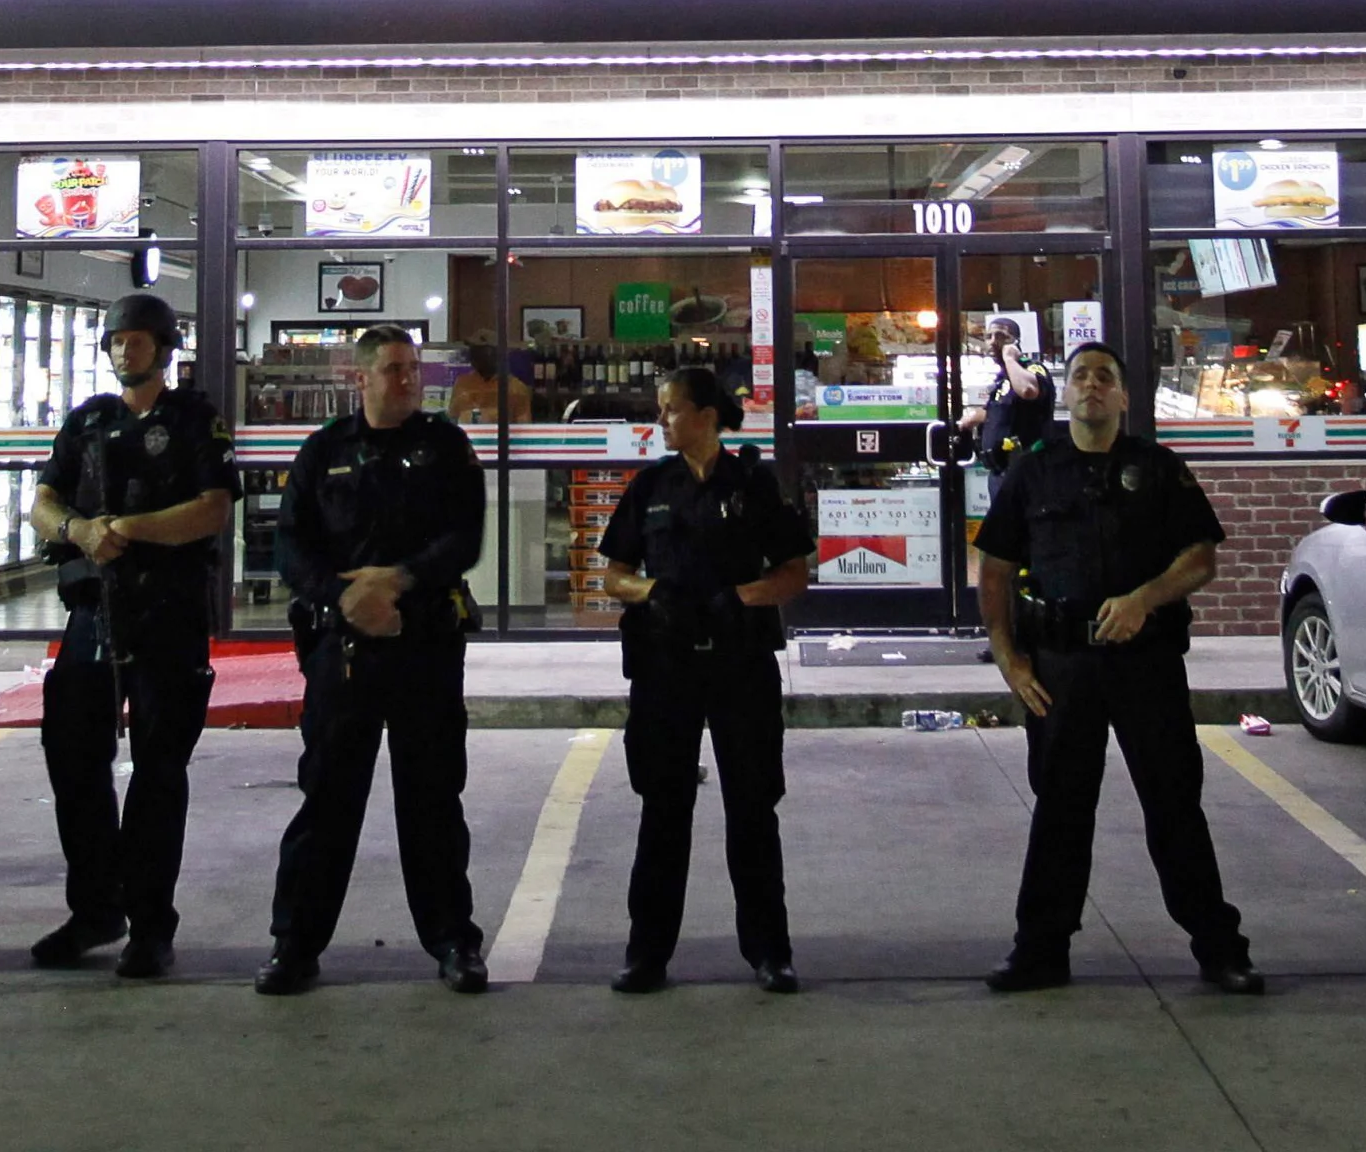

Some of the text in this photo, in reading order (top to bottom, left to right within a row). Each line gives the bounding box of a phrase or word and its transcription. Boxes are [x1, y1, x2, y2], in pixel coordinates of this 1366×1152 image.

[316, 168, 339, 176] YOUR
[913, 203, 972, 234] 1010
[618, 294, 665, 314] coffee
[1068, 328, 1096, 338] FREE
[837, 551, 887, 575] Marlboro
